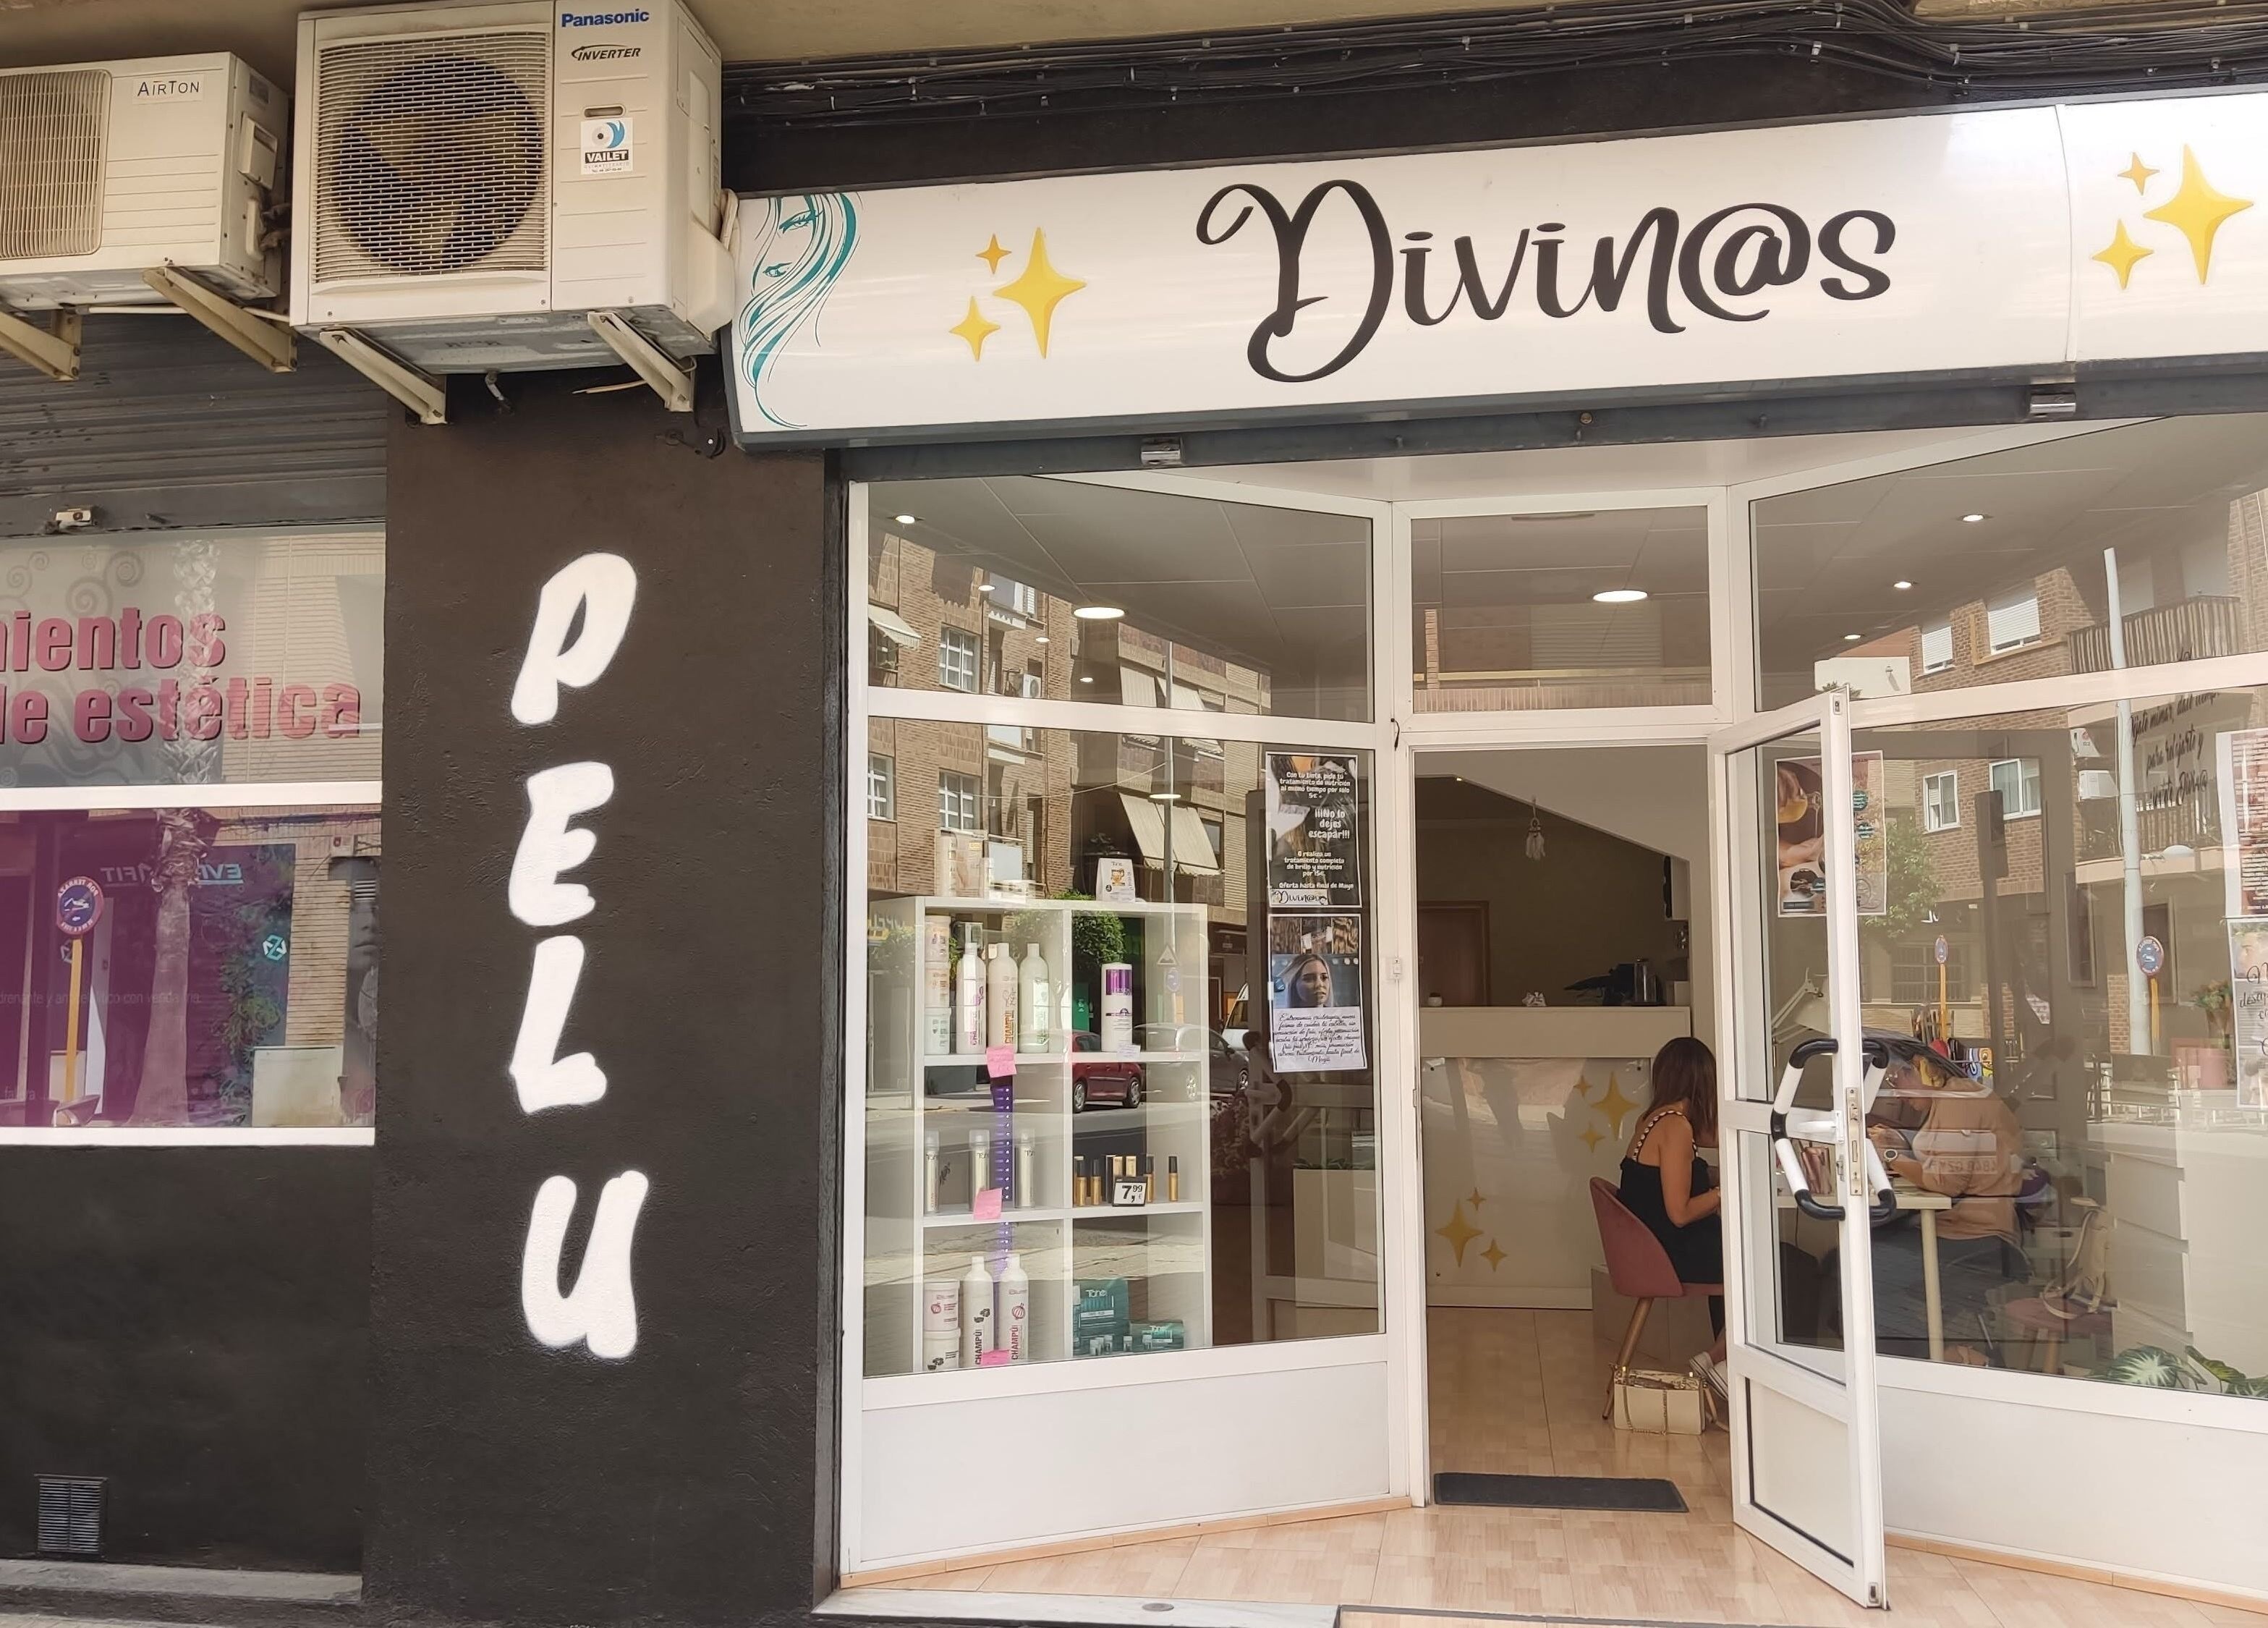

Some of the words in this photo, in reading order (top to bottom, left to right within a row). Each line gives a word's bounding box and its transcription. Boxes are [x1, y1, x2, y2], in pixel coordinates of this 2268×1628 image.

[561, 9, 650, 27] Panasonic
[577, 47, 642, 62] INVERTER
[586, 150, 628, 164] VAILET
[1195, 178, 1897, 383] Divin@s
[0, 606, 226, 671] ientos
[0, 683, 48, 745] e
[73, 674, 361, 744] estética
[1338, 808, 1346, 818] lo
[1319, 818, 1341, 831] dejas
[508, 552, 649, 1360] PELU
